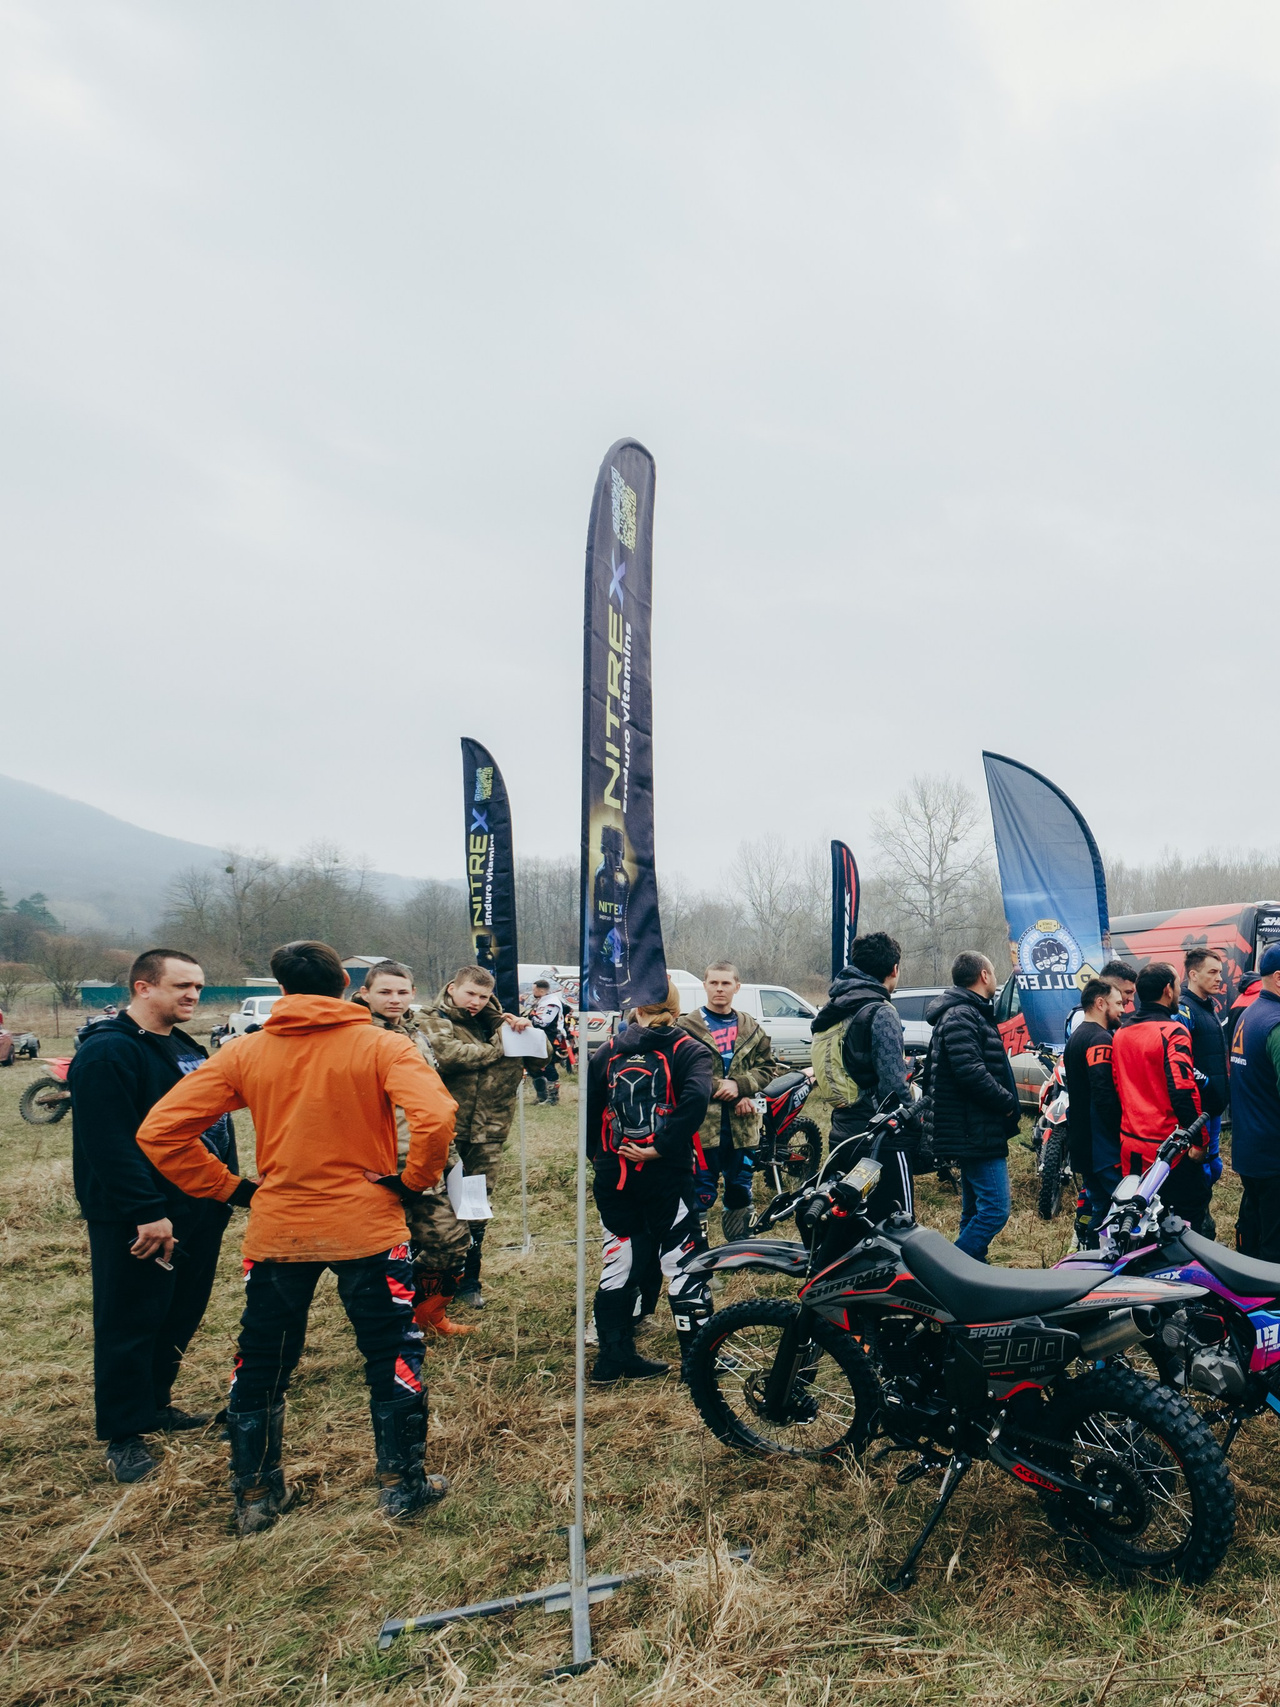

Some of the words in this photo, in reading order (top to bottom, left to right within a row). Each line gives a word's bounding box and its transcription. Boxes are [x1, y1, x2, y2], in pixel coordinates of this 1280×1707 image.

[604, 547, 626, 810] NITREX
[621, 621, 632, 722] vitamins
[623, 729, 632, 814] Enduro
[468, 807, 489, 927] NITREX
[485, 833, 495, 883] vitamins
[484, 884, 493, 926] Enduro
[806, 1262, 899, 1300] SHARMAX
[901, 1300, 937, 1316] NIBBI
[968, 1324, 1016, 1339] SPORT
[982, 1335, 1065, 1367] 300
